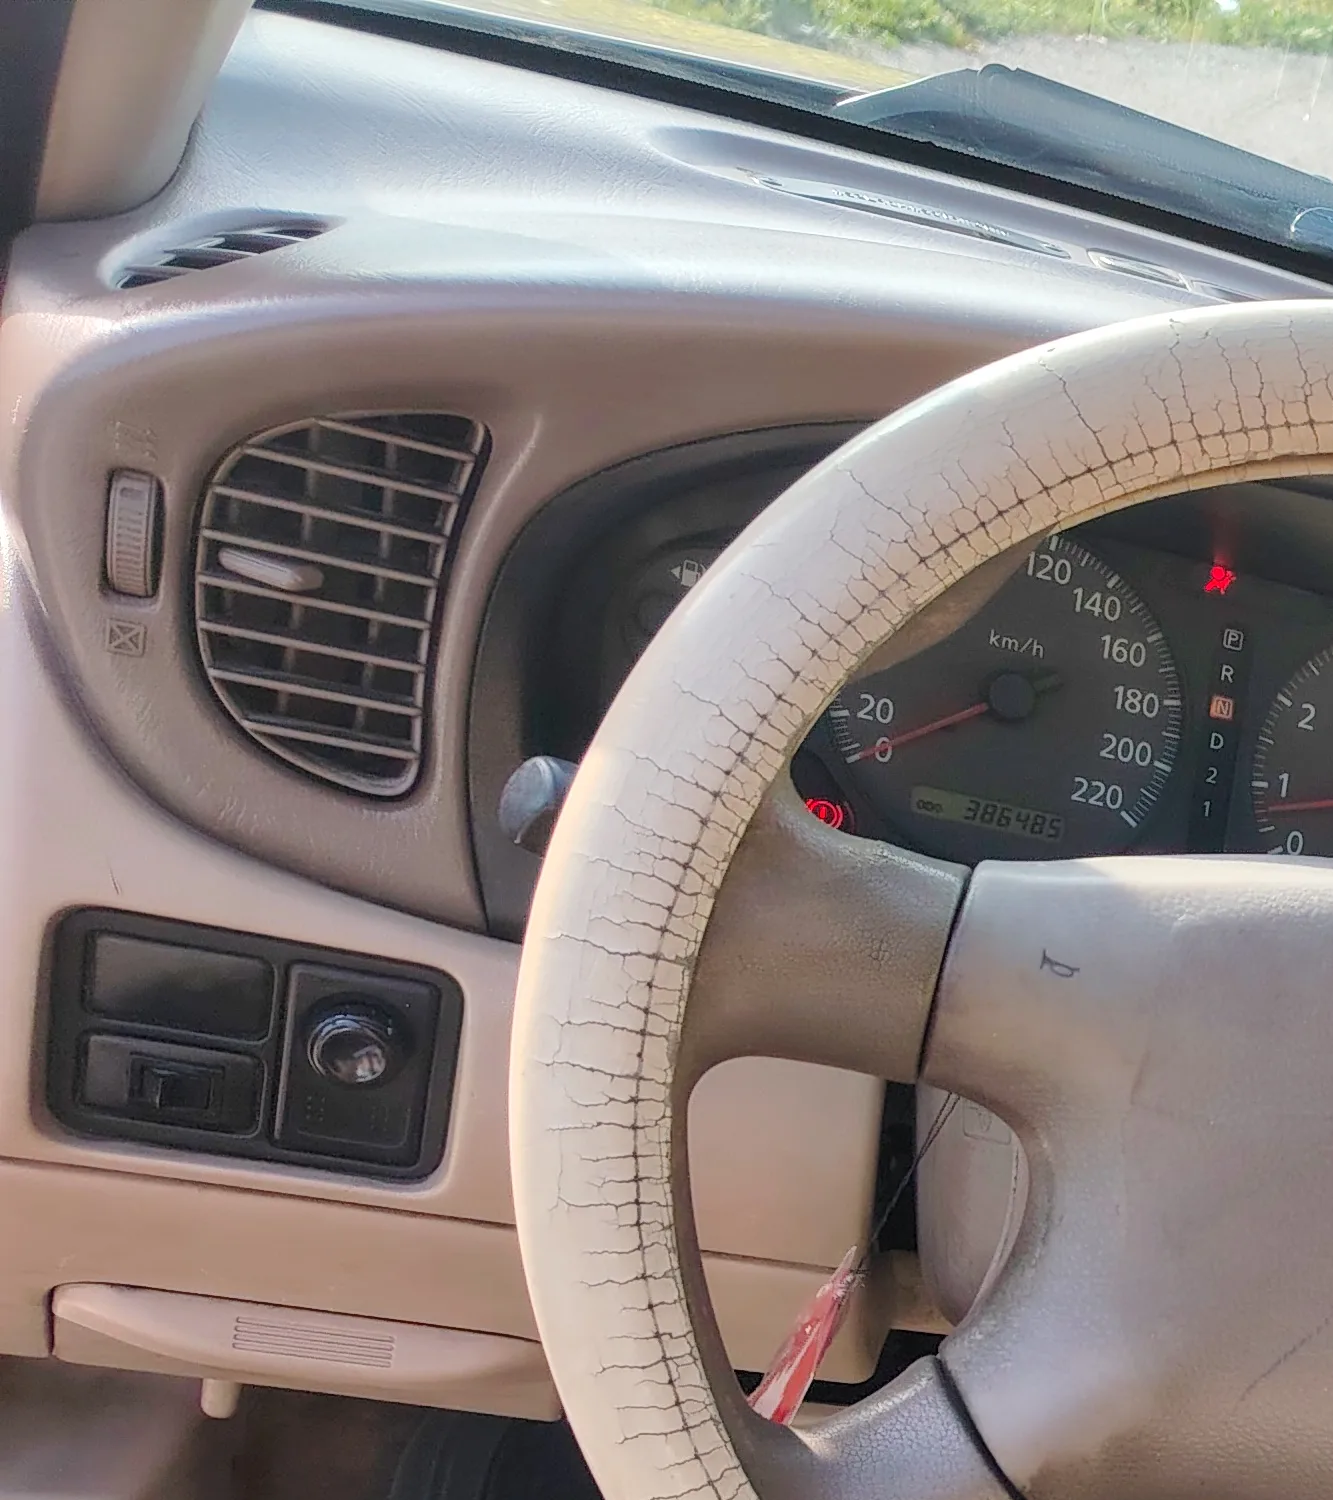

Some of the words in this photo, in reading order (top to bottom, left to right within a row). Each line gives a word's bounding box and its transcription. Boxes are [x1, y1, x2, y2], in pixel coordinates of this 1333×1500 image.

[1025, 550, 1072, 585] 120
[1072, 587, 1121, 622] 140
[988, 628, 1045, 659] km/h
[1100, 634, 1147, 667] 160
[1226, 632, 1240, 648] P
[1220, 665, 1234, 682] R
[856, 692, 894, 724] 20
[1113, 685, 1159, 718] 180
[1216, 700, 1230, 717] N
[1297, 704, 1317, 731] 2
[874, 736, 893, 764] 0
[1099, 733, 1152, 768] 200
[1210, 733, 1224, 750] D
[1205, 767, 1219, 785] 2
[1279, 772, 1290, 798] 1
[1070, 776, 1123, 811] 220
[963, 799, 1063, 841] 386485
[1202, 801, 1212, 818] 1
[1285, 831, 1304, 855] 0
